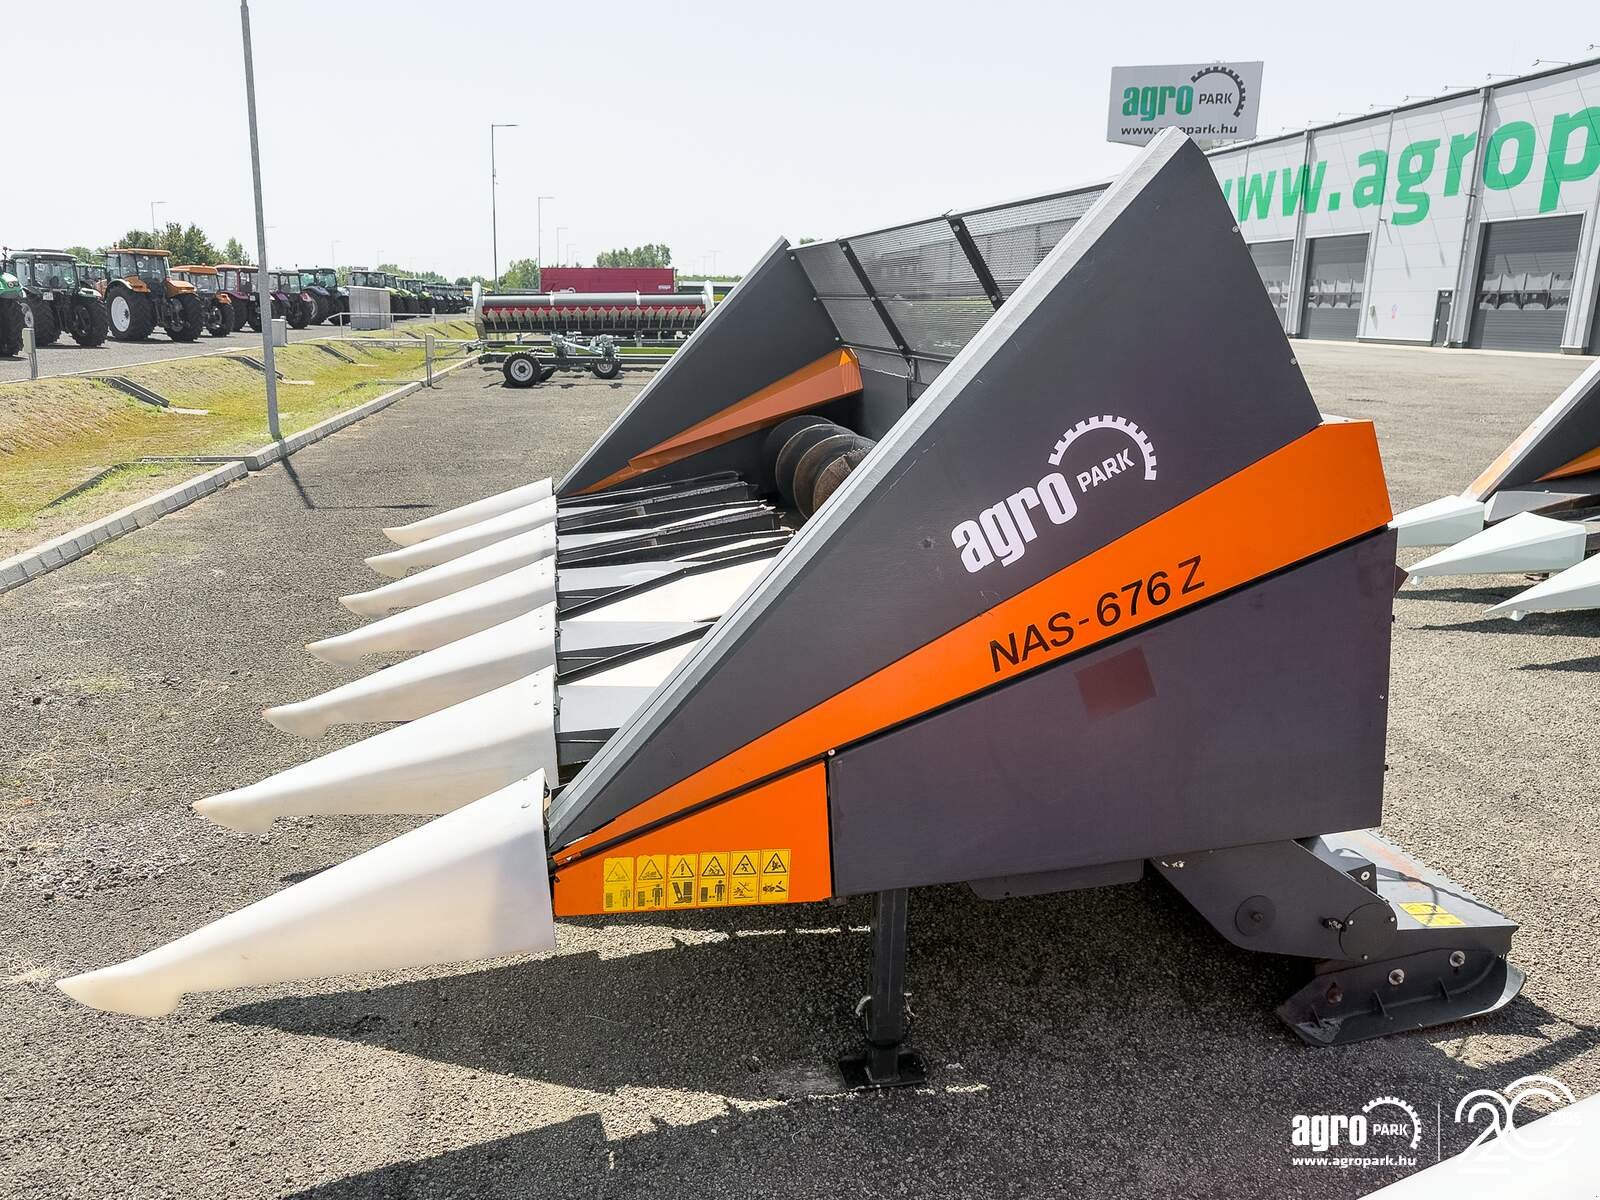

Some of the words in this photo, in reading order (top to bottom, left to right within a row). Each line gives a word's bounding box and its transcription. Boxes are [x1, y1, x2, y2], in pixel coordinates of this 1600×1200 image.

[1122, 85, 1194, 121] agro
[1198, 92, 1232, 104] PARK
[1121, 124, 1238, 135] www.opark.hu
[1223, 106, 1600, 226] ww.agrop
[951, 472, 1078, 573] agro
[1076, 448, 1135, 492] PARK
[1178, 555, 1205, 594] Z
